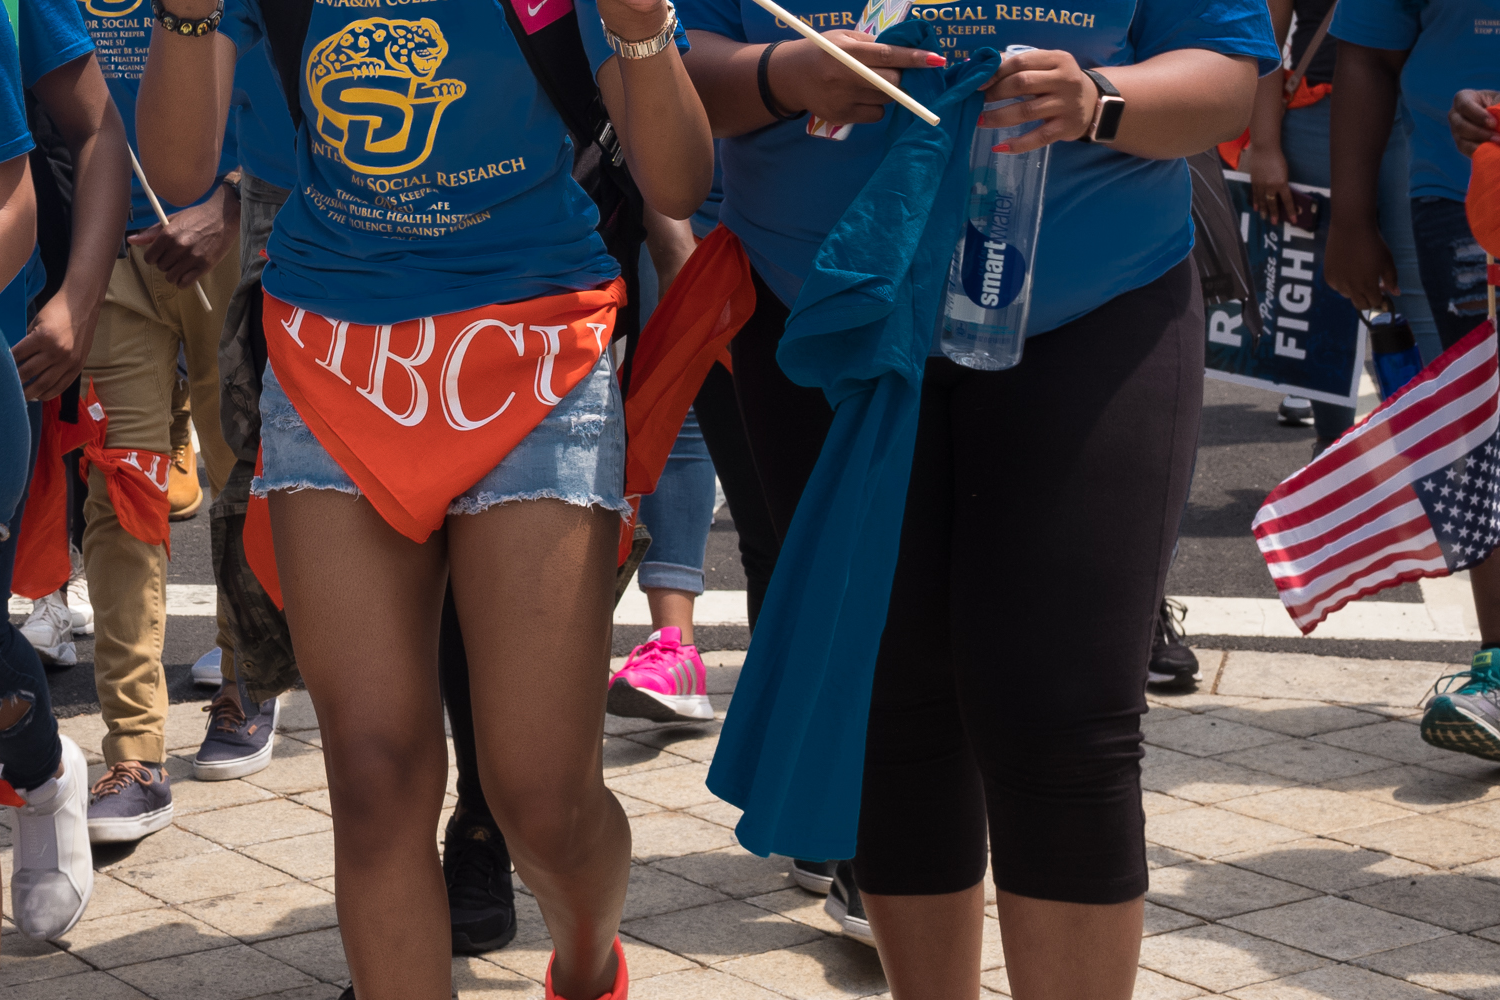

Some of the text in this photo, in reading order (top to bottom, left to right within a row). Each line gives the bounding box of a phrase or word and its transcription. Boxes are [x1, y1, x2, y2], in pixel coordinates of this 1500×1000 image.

[102, 18, 139, 28] SOCIAL
[911, 5, 988, 21] SOCIAL
[995, 4, 1095, 28] RESEARCH
[948, 25, 996, 35] KEEPER
[437, 156, 527, 188] RESEARCH
[349, 204, 384, 219] PUBLIC
[386, 211, 432, 224] HEALTH
[396, 225, 447, 237] AGAINST
[1264, 231, 1279, 252] To
[1259, 256, 1277, 321] Promise
[1274, 221, 1315, 360] FIGHT
